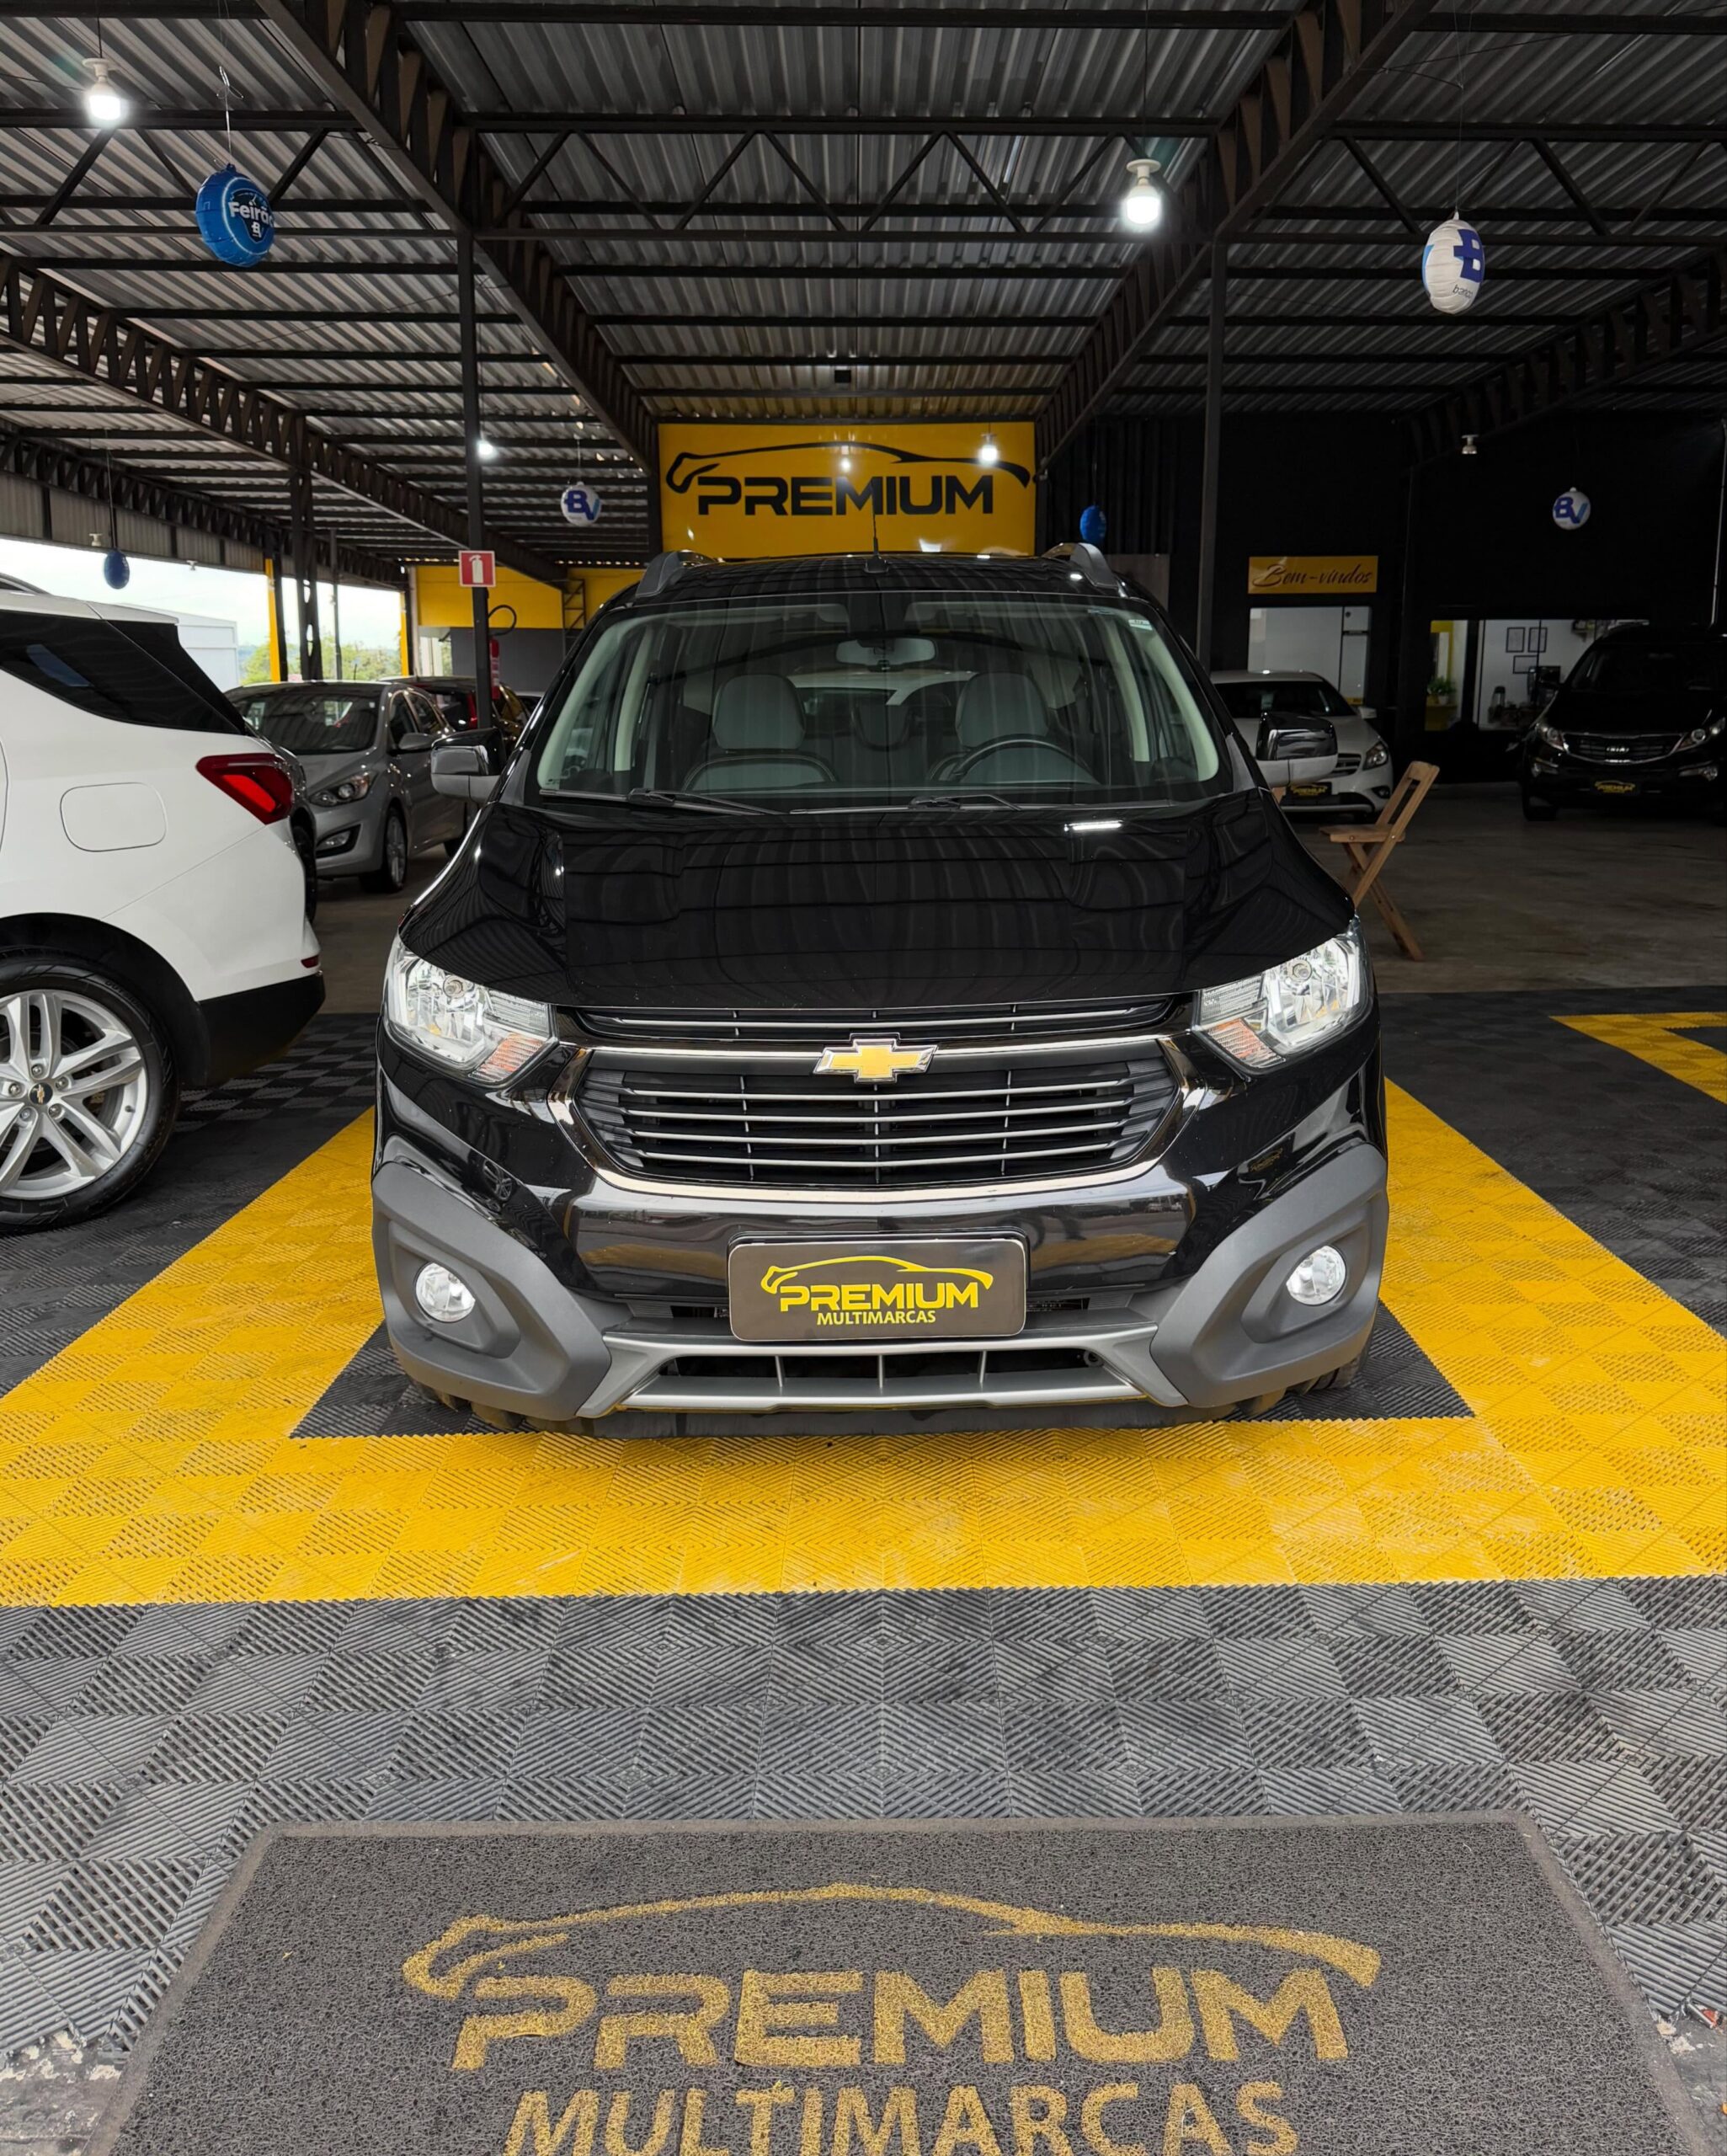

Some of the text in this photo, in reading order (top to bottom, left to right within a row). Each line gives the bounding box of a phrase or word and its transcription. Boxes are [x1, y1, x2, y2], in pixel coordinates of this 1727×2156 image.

[564, 490, 600, 520] BV
[697, 475, 994, 515] PREMIUM
[1554, 496, 1588, 524] BV
[1252, 563, 1373, 588] Bem-vindos
[780, 1282, 979, 1312] PREMIUM
[816, 1310, 936, 1326] MULTIMARCAS
[452, 1966, 1349, 2072] PREMIUM
[504, 2081, 1299, 2156] MULTIMARCAS
